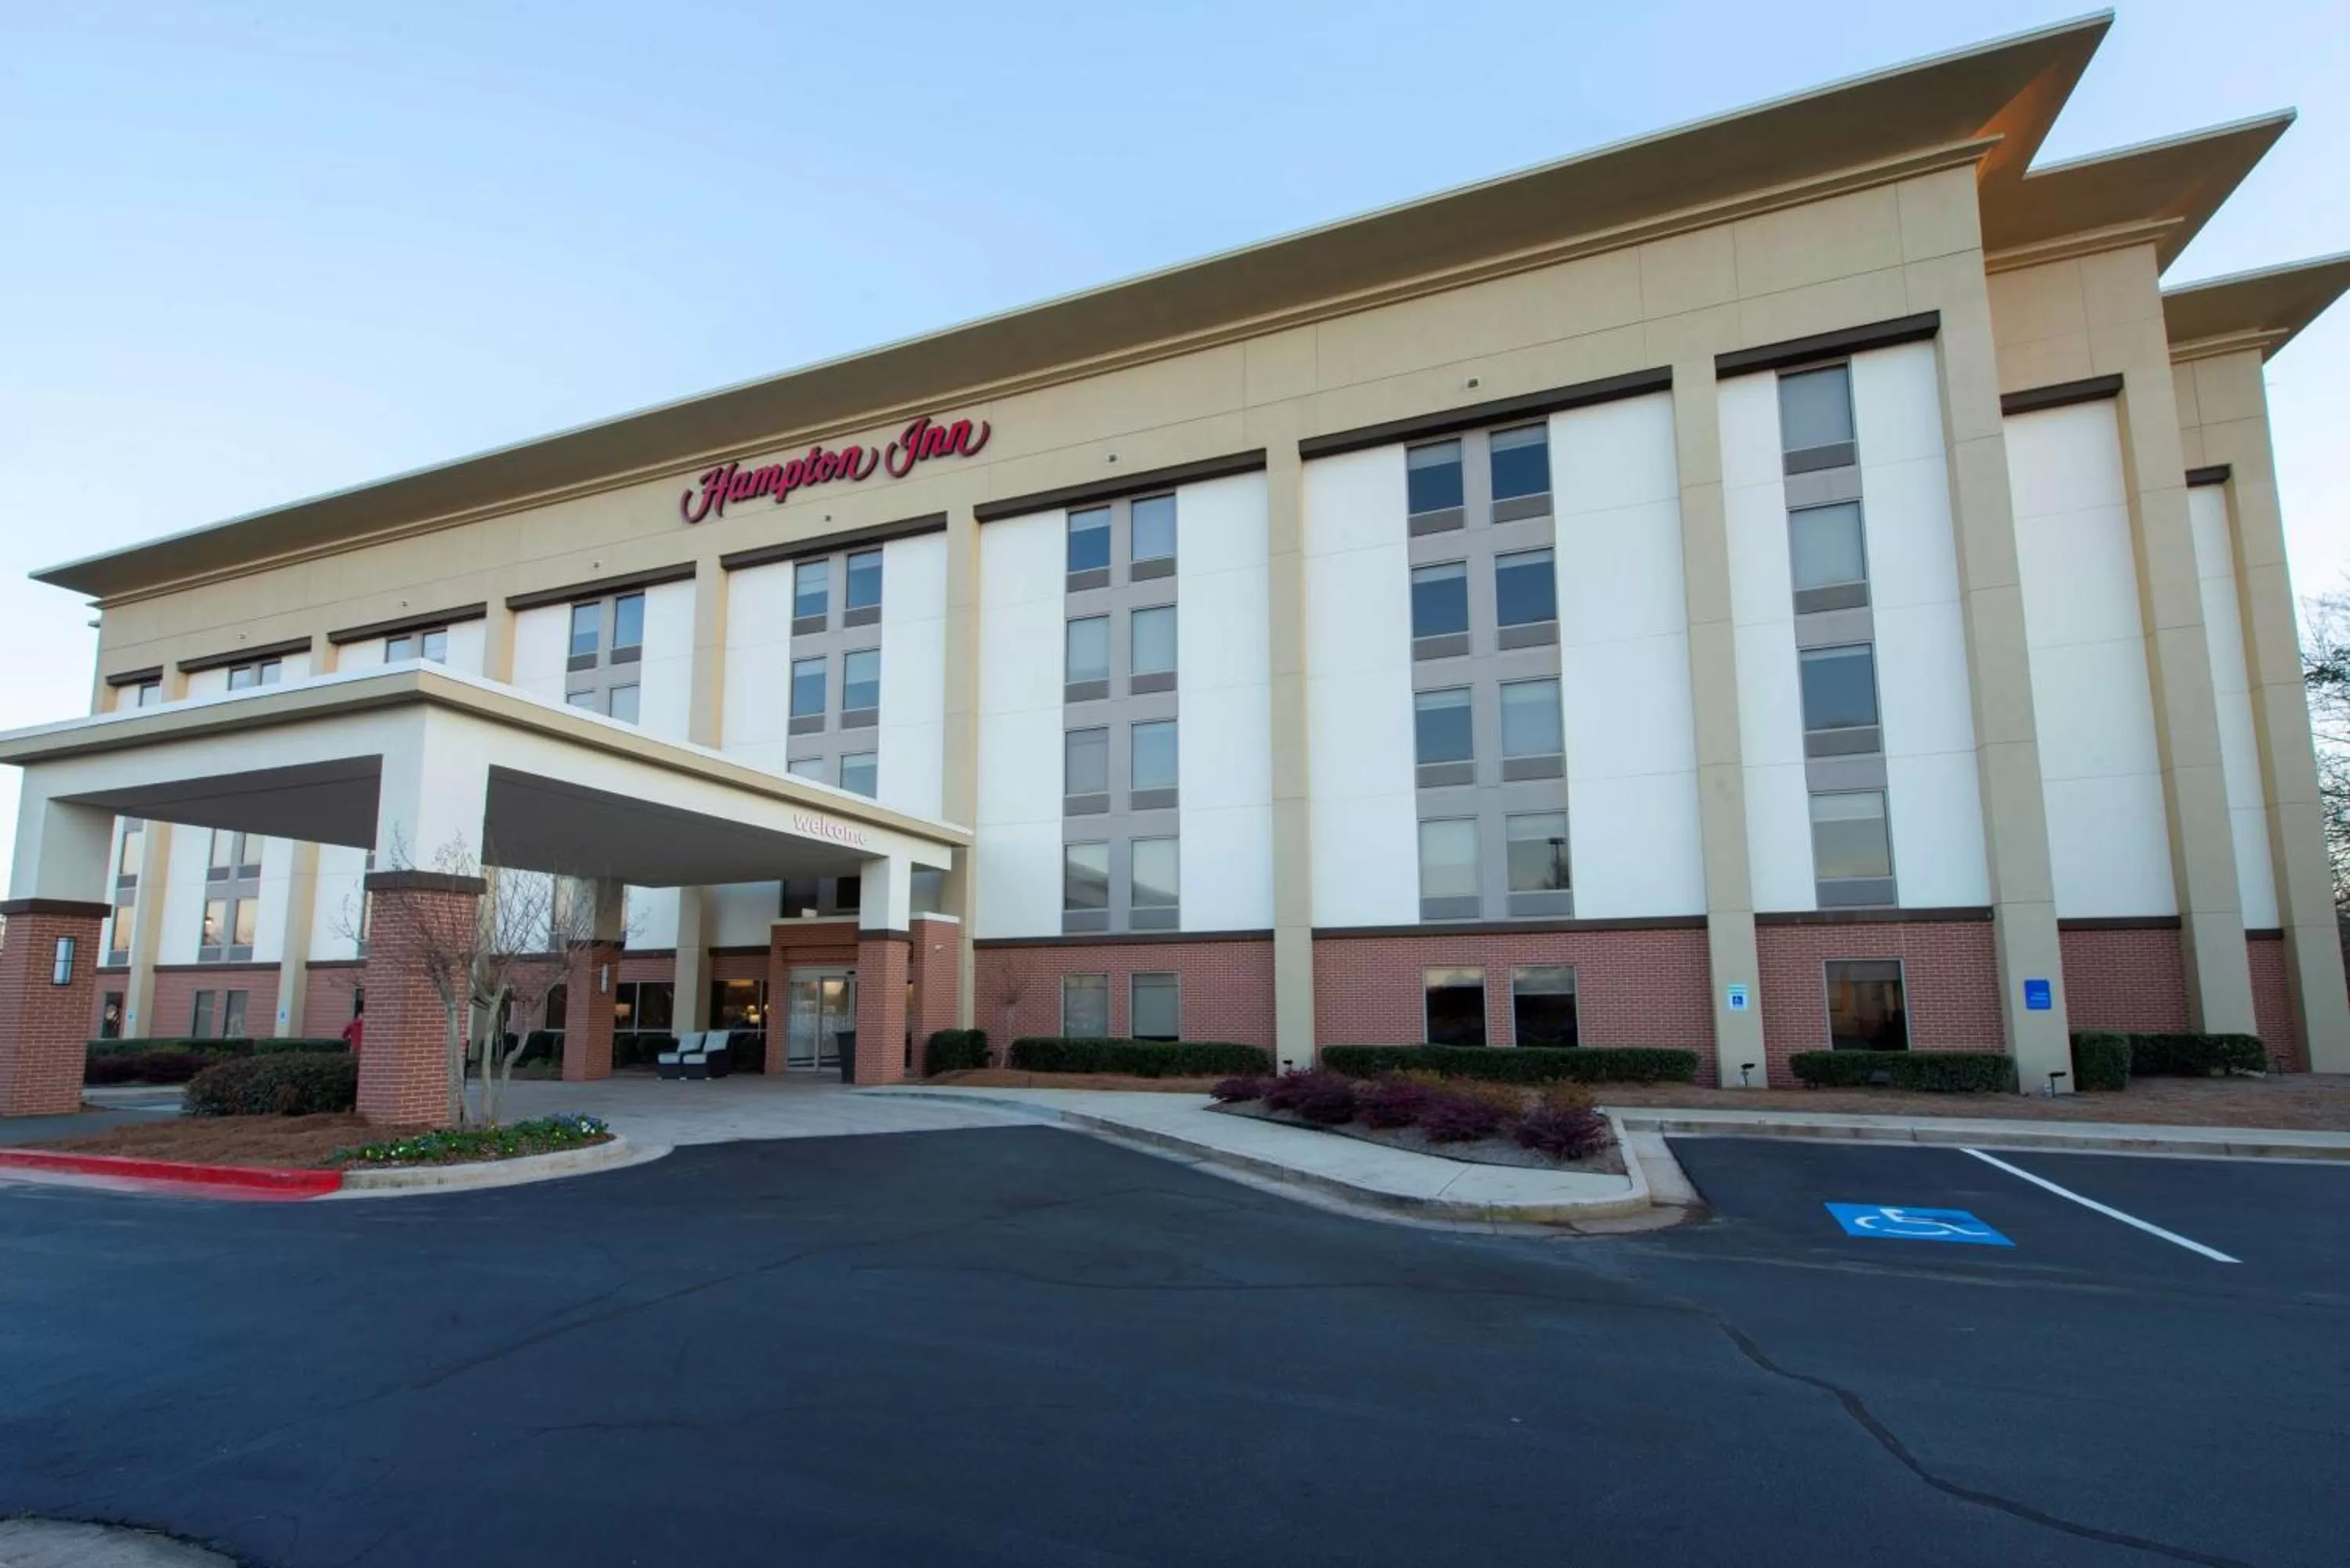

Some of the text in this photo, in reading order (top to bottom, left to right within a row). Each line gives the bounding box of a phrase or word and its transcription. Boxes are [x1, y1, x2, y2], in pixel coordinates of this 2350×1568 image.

[680, 416, 991, 524] Hampton Inn
[793, 813, 868, 846] welcome
